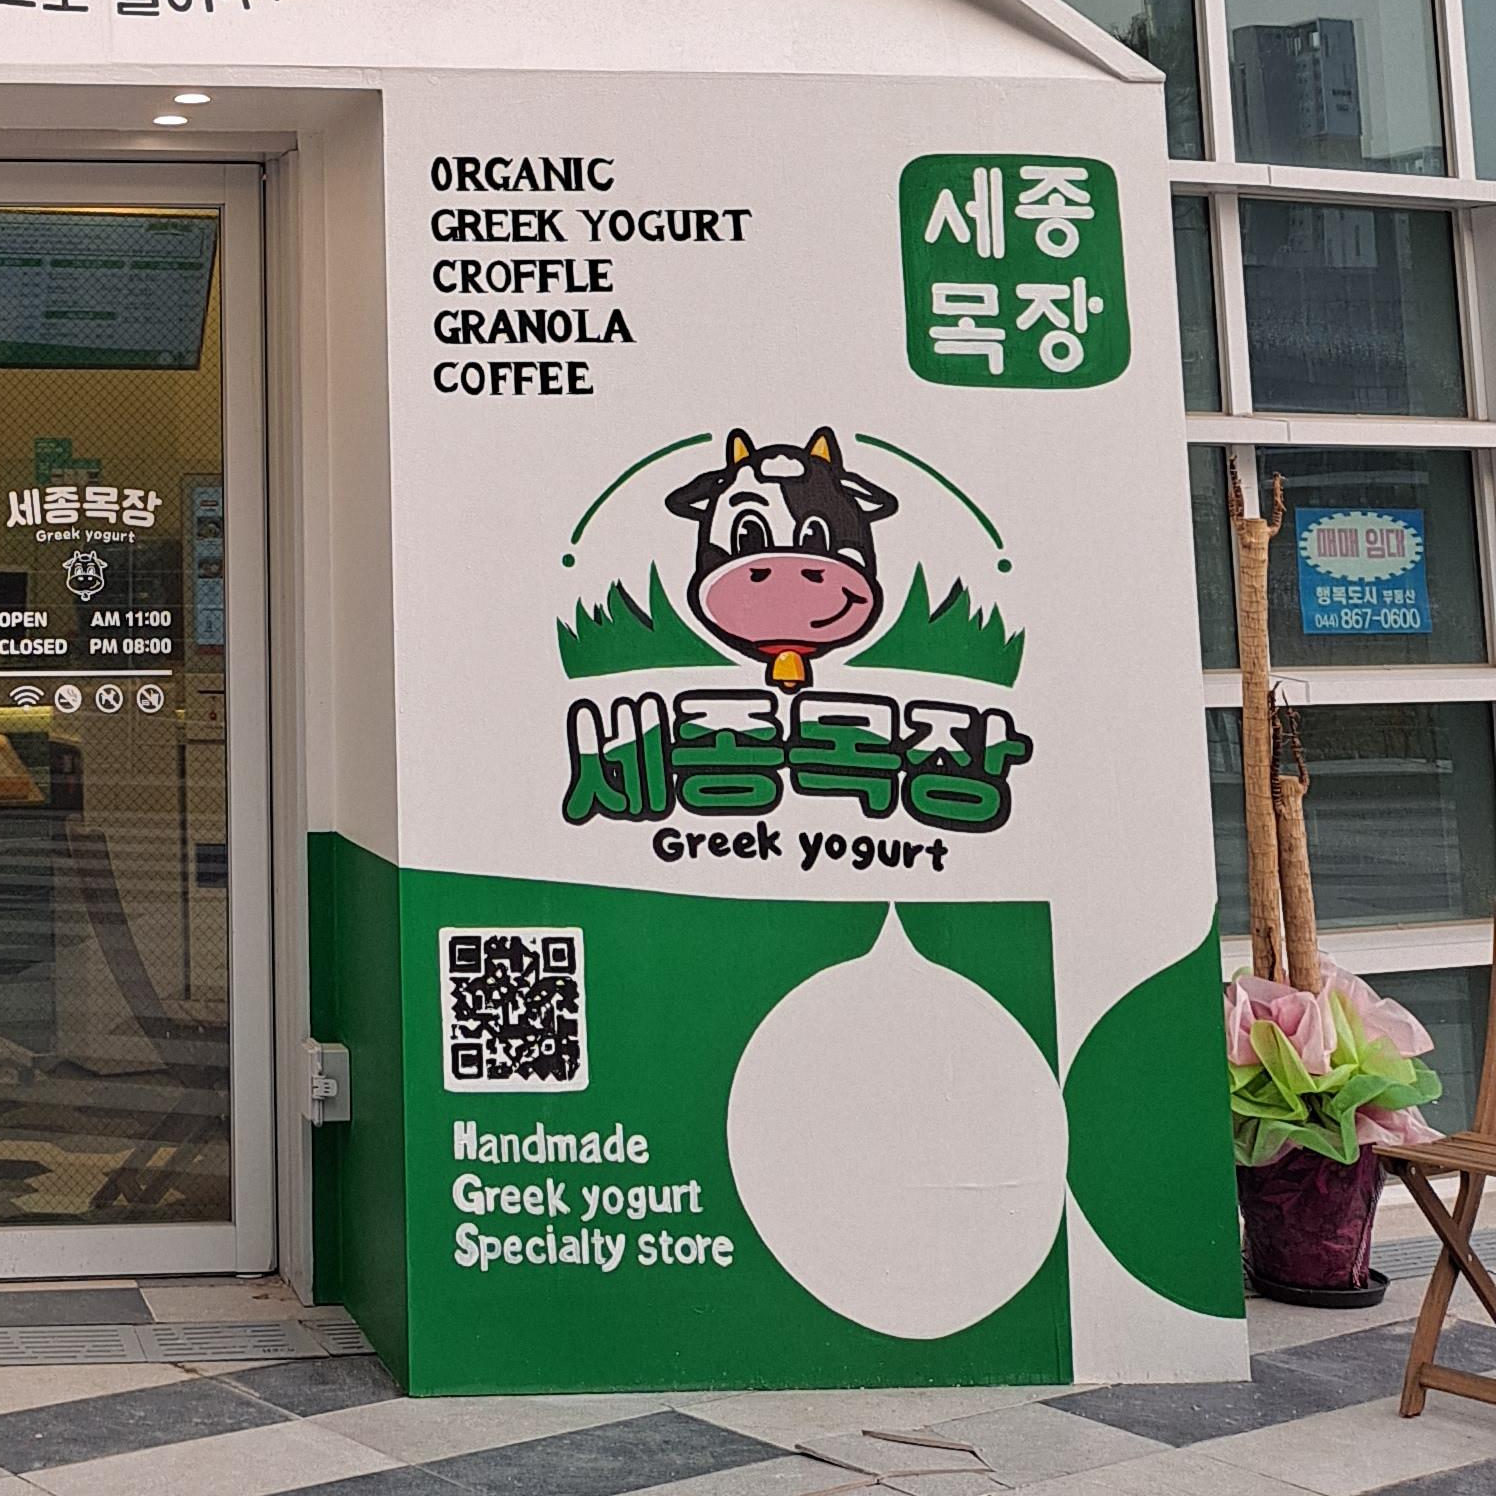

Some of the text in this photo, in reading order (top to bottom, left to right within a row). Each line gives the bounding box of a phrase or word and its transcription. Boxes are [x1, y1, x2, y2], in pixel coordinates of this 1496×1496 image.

[431, 156, 615, 192] ORGANIC
[430, 208, 753, 243] GREEK YOGURT
[924, 164, 1095, 260] 세종
[432, 259, 614, 294] CROFFLE
[433, 309, 637, 345] GRANOLA
[929, 276, 1104, 375] 목장
[433, 361, 594, 396] COFFEE
[6, 486, 163, 528] 세종목장
[35, 526, 136, 544] Greek yogurt
[1316, 527, 1406, 559] 매매 임대
[1316, 586, 1416, 605] 행복도시 부동산
[90, 611, 120, 627] AM
[125, 611, 172, 627] 11:00
[89, 638, 118, 654] PM
[122, 637, 172, 654] 08:00
[561, 688, 1034, 834] 세종목장
[652, 821, 949, 872] Greek yogurt
[453, 1120, 650, 1165] Handmade
[452, 1173, 704, 1221] Greek yogurt
[453, 1223, 735, 1273] Specialty store
